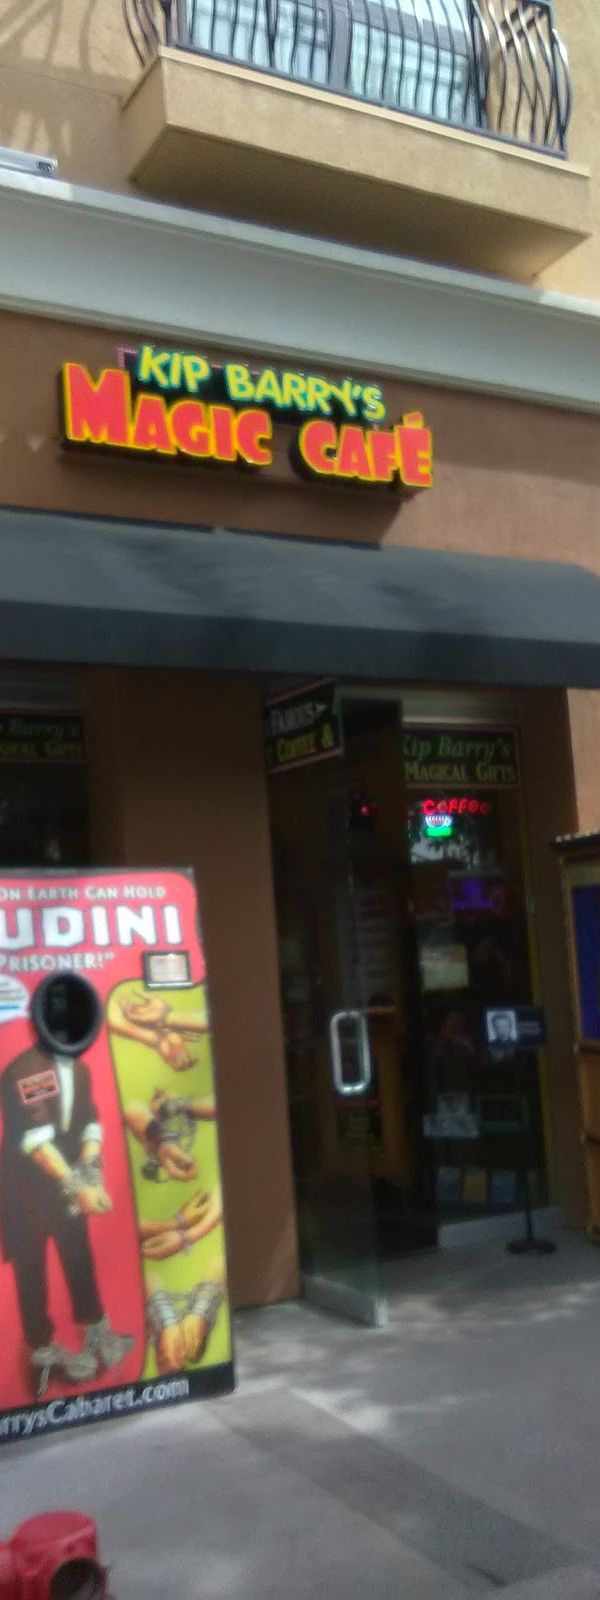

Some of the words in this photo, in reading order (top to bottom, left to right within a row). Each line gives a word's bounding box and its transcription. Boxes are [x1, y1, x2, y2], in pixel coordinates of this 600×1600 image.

[138, 345, 211, 393] KIP
[226, 363, 386, 421] BARRY'S
[63, 362, 272, 465] MAGIC
[301, 411, 432, 487] CAFÉ
[404, 761, 467, 781] MAGICAL
[476, 761, 513, 781] GIFTS
[85, 885, 119, 899] CAN
[124, 885, 166, 898] HOLD
